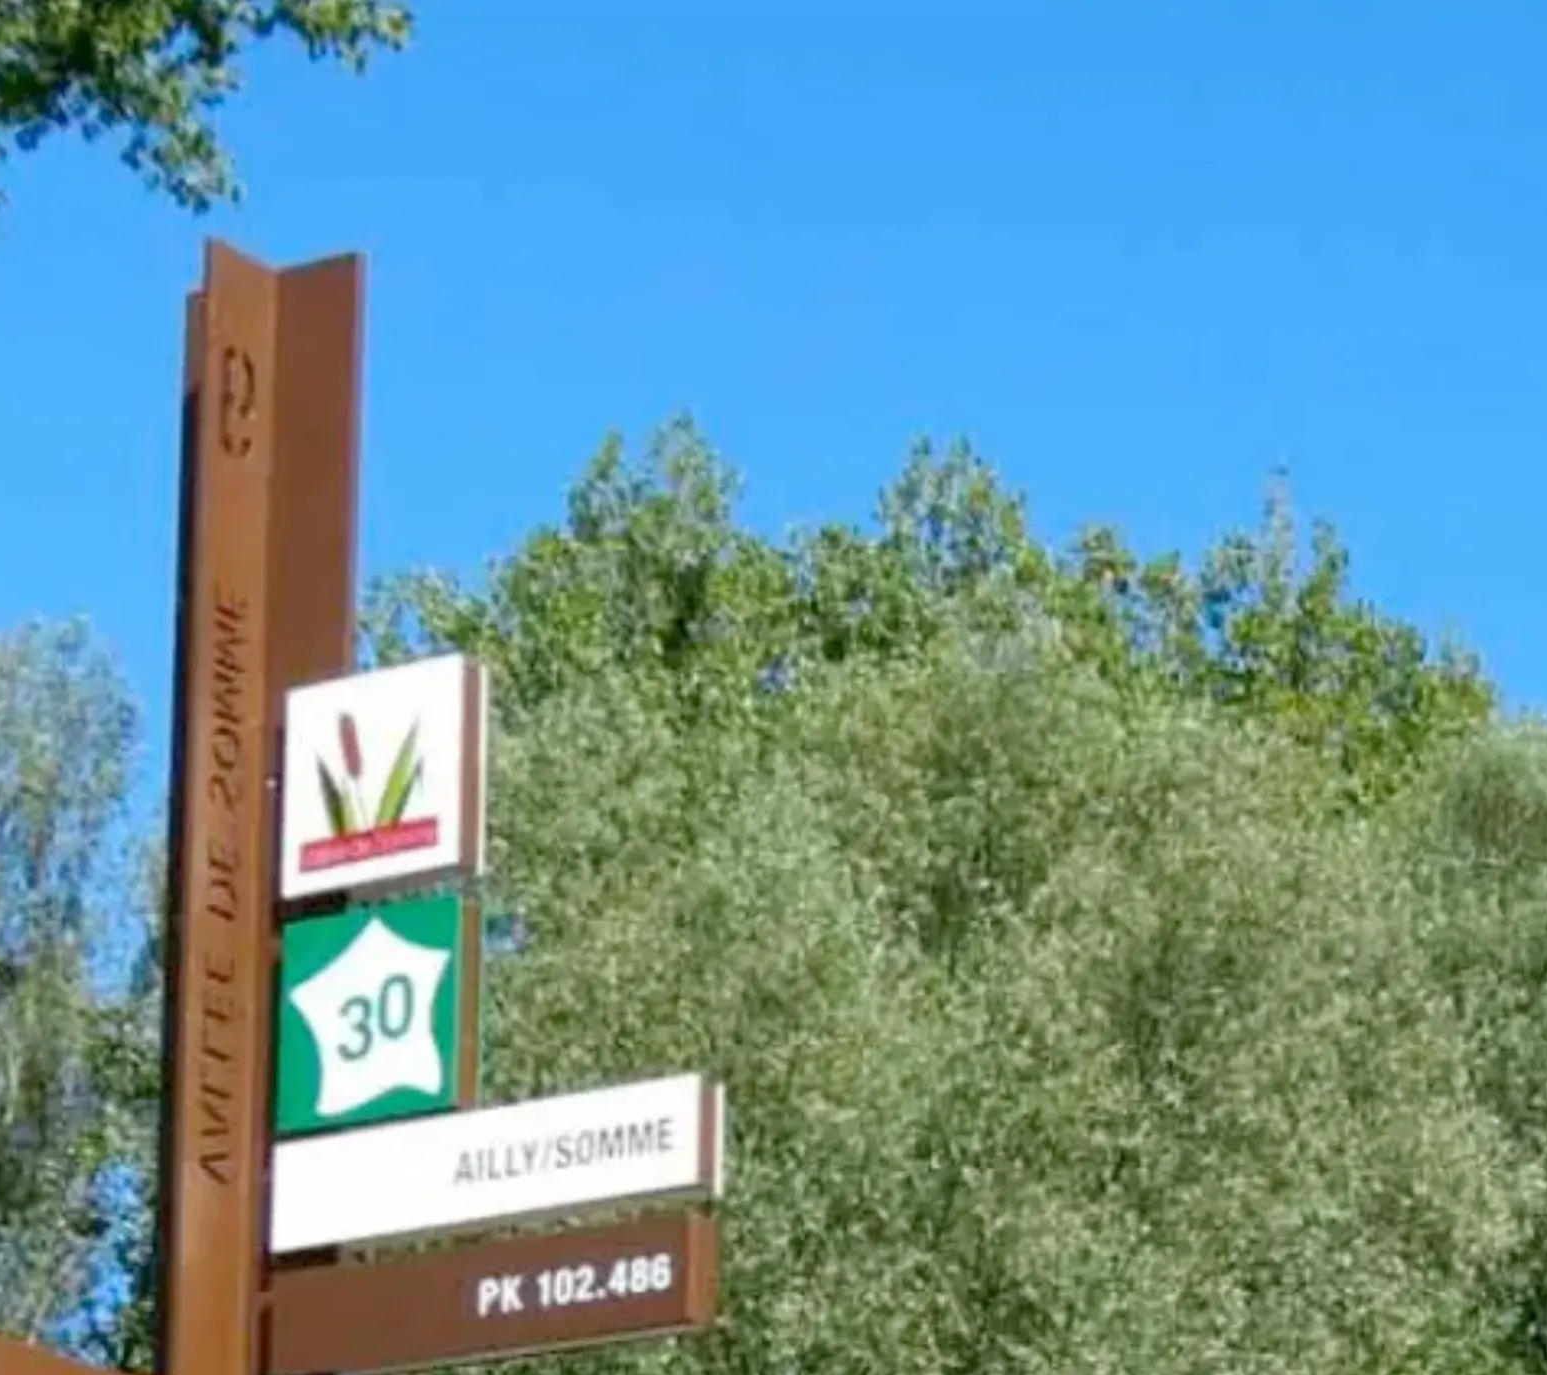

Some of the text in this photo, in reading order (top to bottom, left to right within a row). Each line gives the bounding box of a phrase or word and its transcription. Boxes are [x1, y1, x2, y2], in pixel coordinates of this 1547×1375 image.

[338, 973, 415, 1062] 30
[454, 1118, 674, 1184] AILLY/SOMME
[476, 1252, 674, 1319] PK 102.486
